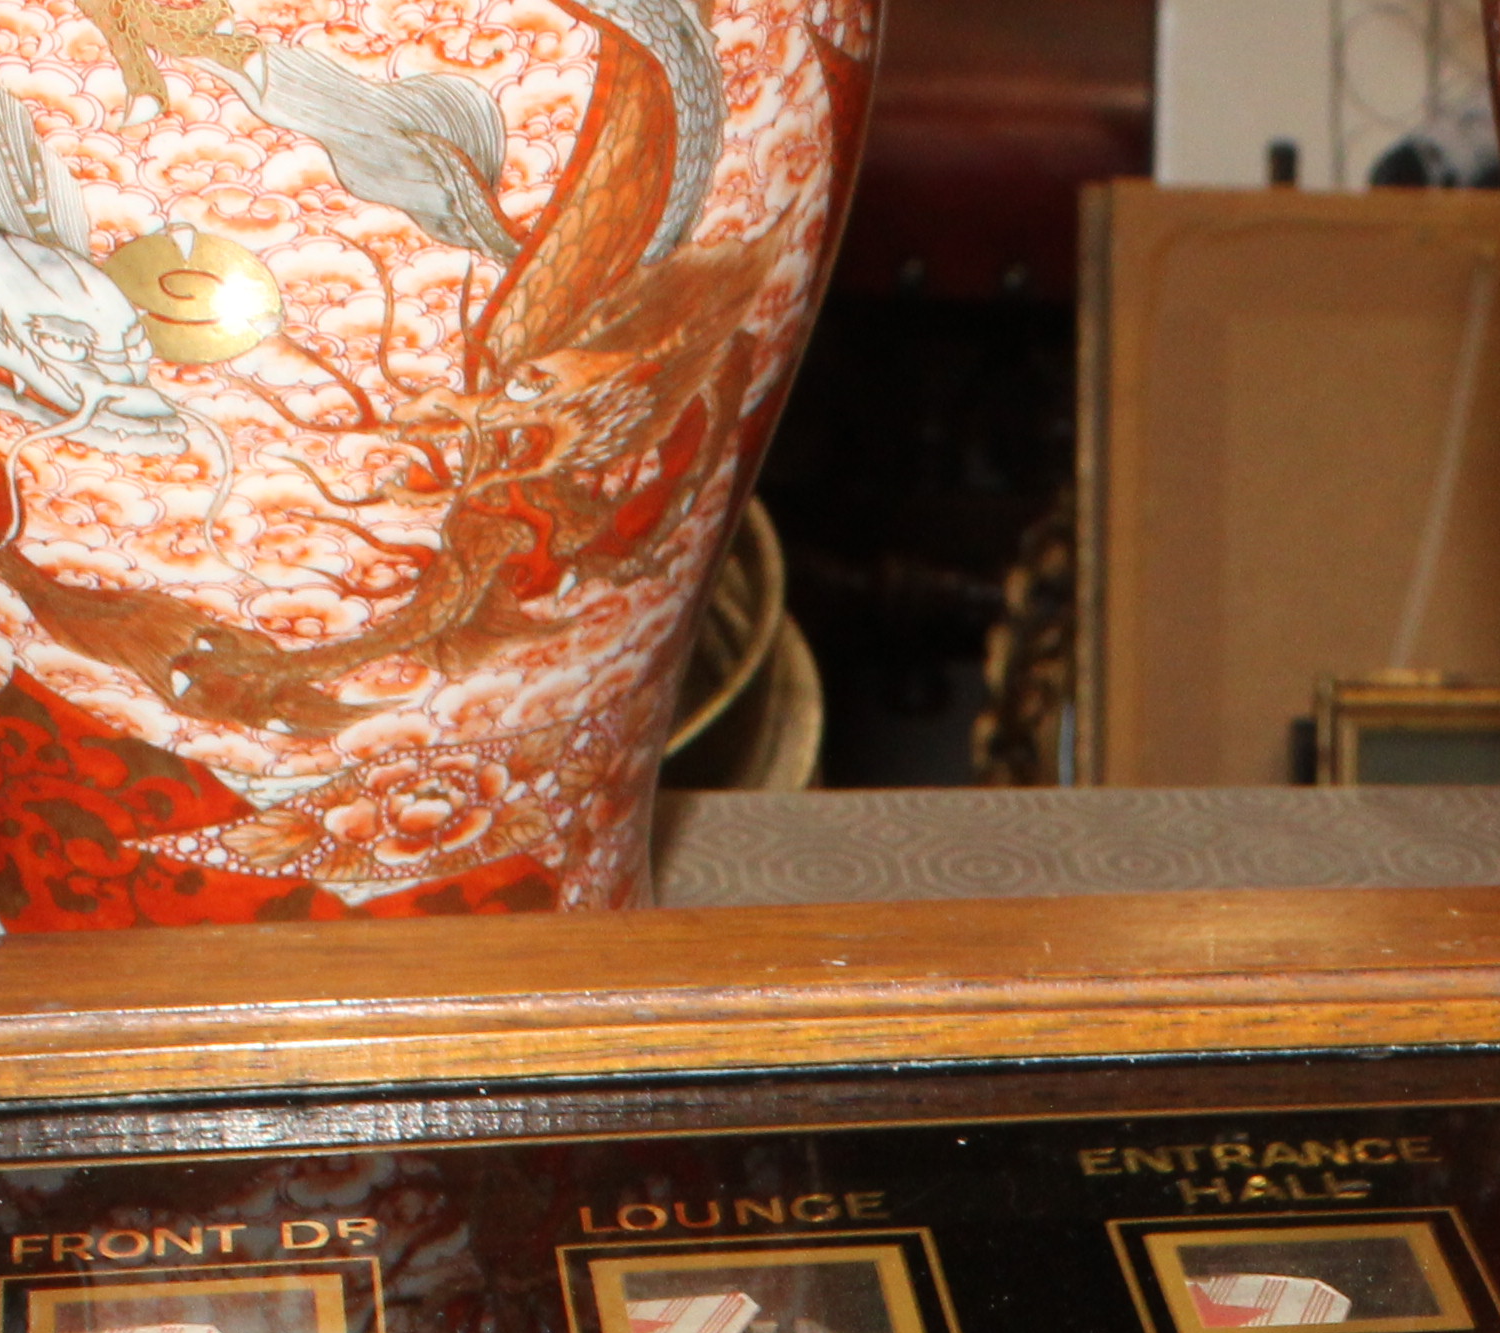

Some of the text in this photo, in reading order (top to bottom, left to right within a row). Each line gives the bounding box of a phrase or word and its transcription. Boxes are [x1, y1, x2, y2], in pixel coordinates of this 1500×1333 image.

[1076, 1136, 1443, 1176] ENTRANCE
[1177, 1170, 1373, 1205] HALL
[578, 1190, 891, 1235] LOUNGE
[11, 1223, 247, 1265] FRONT
